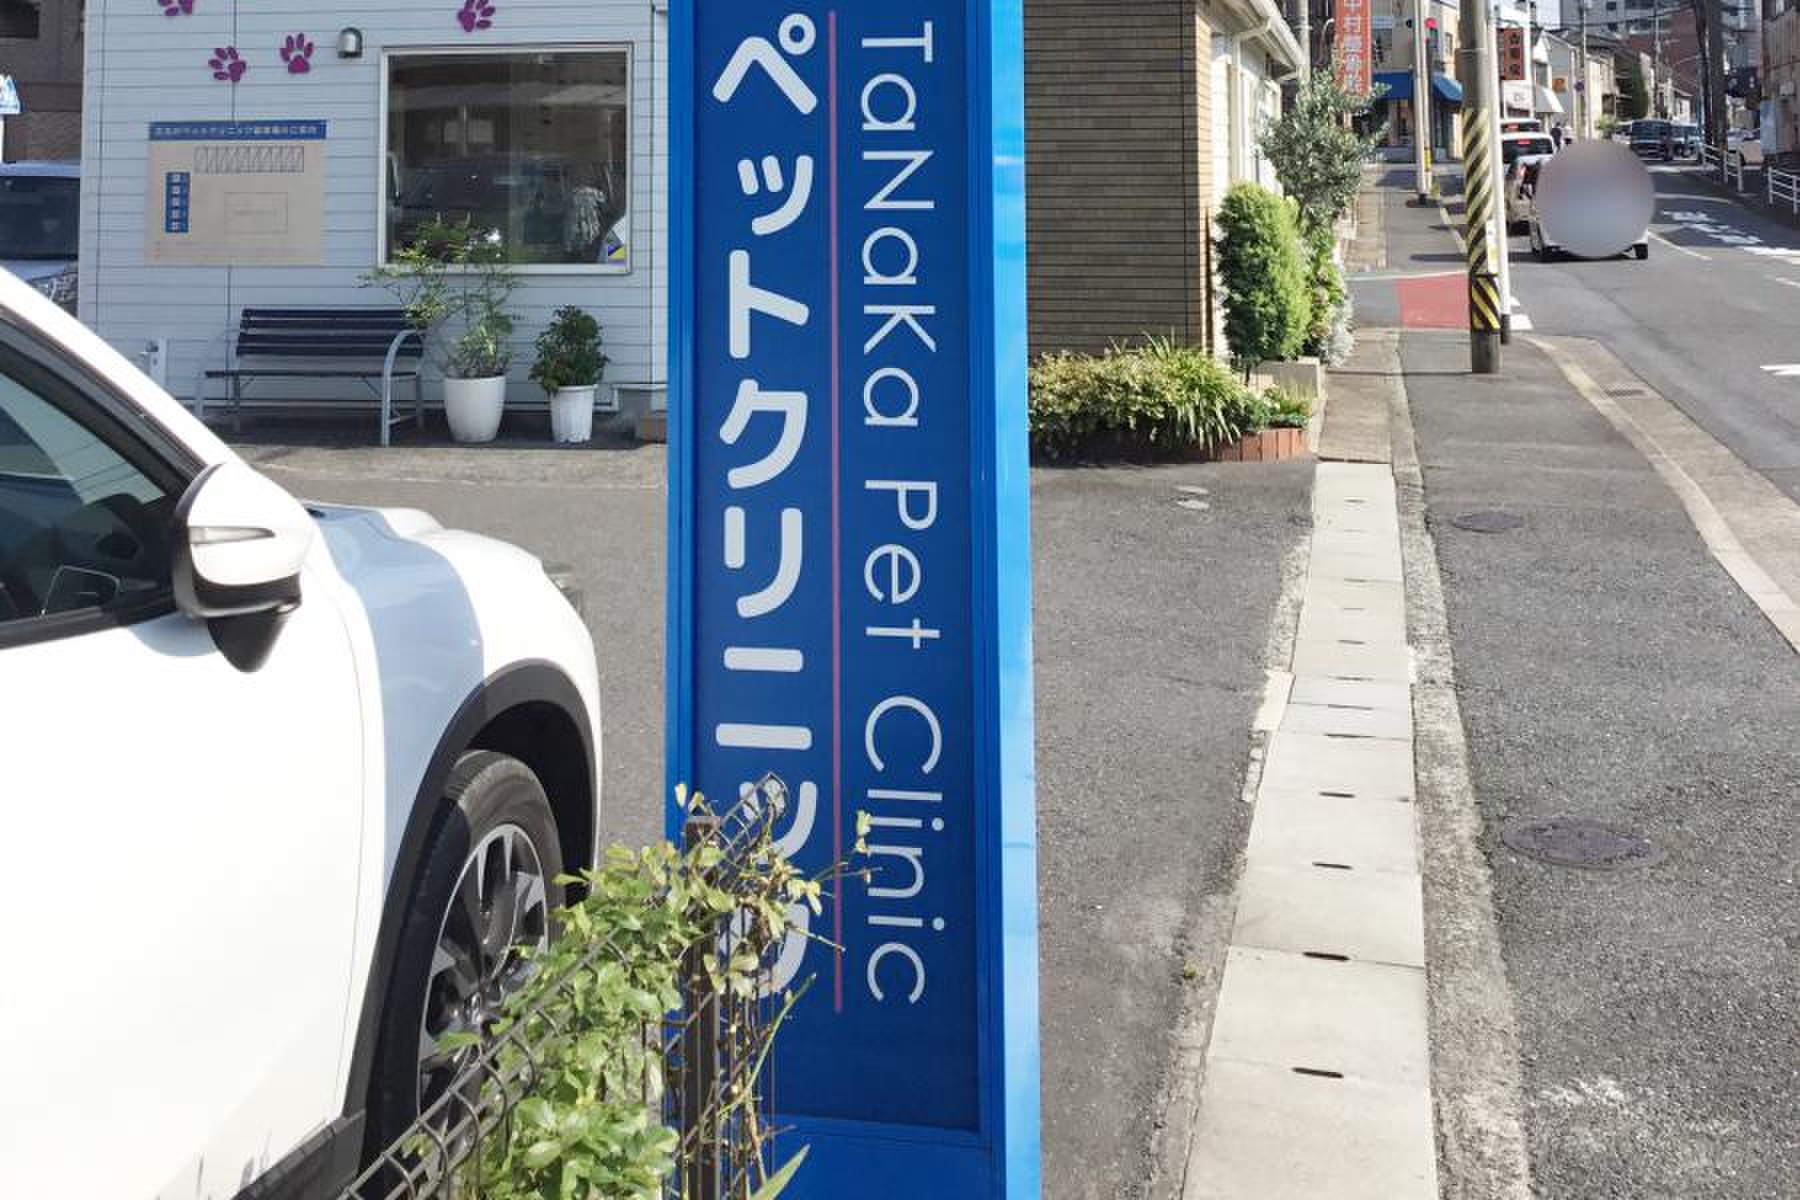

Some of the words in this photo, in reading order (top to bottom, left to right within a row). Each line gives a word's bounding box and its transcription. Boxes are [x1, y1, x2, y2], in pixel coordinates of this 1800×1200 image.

[861, 21, 936, 427] TaNaKa
[863, 479, 941, 649] Pet
[864, 695, 945, 1004] Clinic
